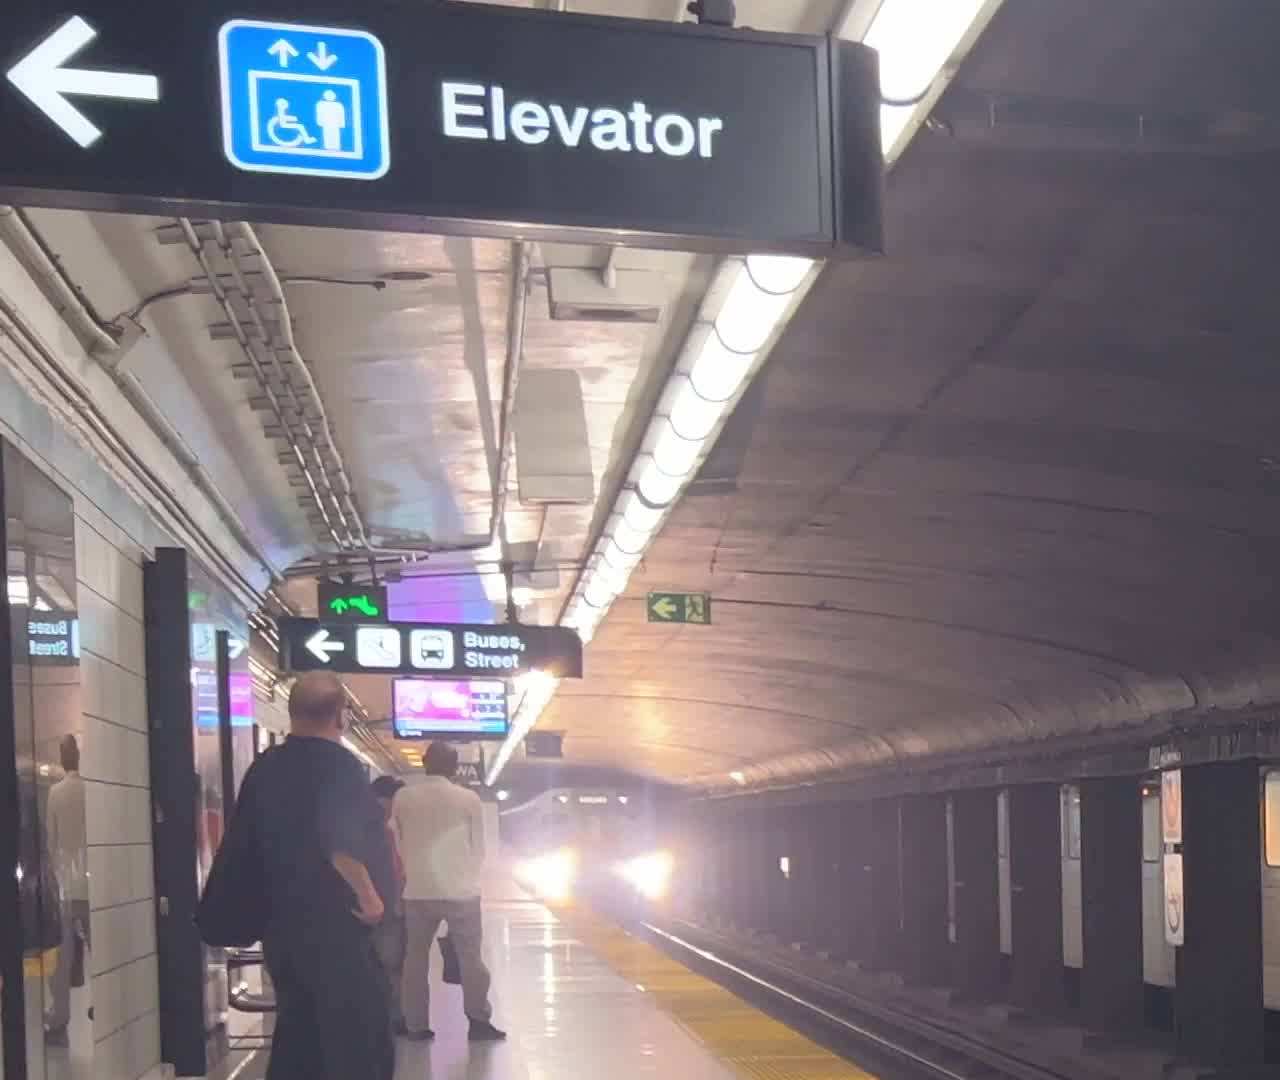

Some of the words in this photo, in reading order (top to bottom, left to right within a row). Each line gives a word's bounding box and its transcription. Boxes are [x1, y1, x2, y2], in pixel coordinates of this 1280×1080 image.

[441, 81, 723, 158] Elevator
[464, 631, 525, 652] Buses,
[464, 651, 518, 668] Street
